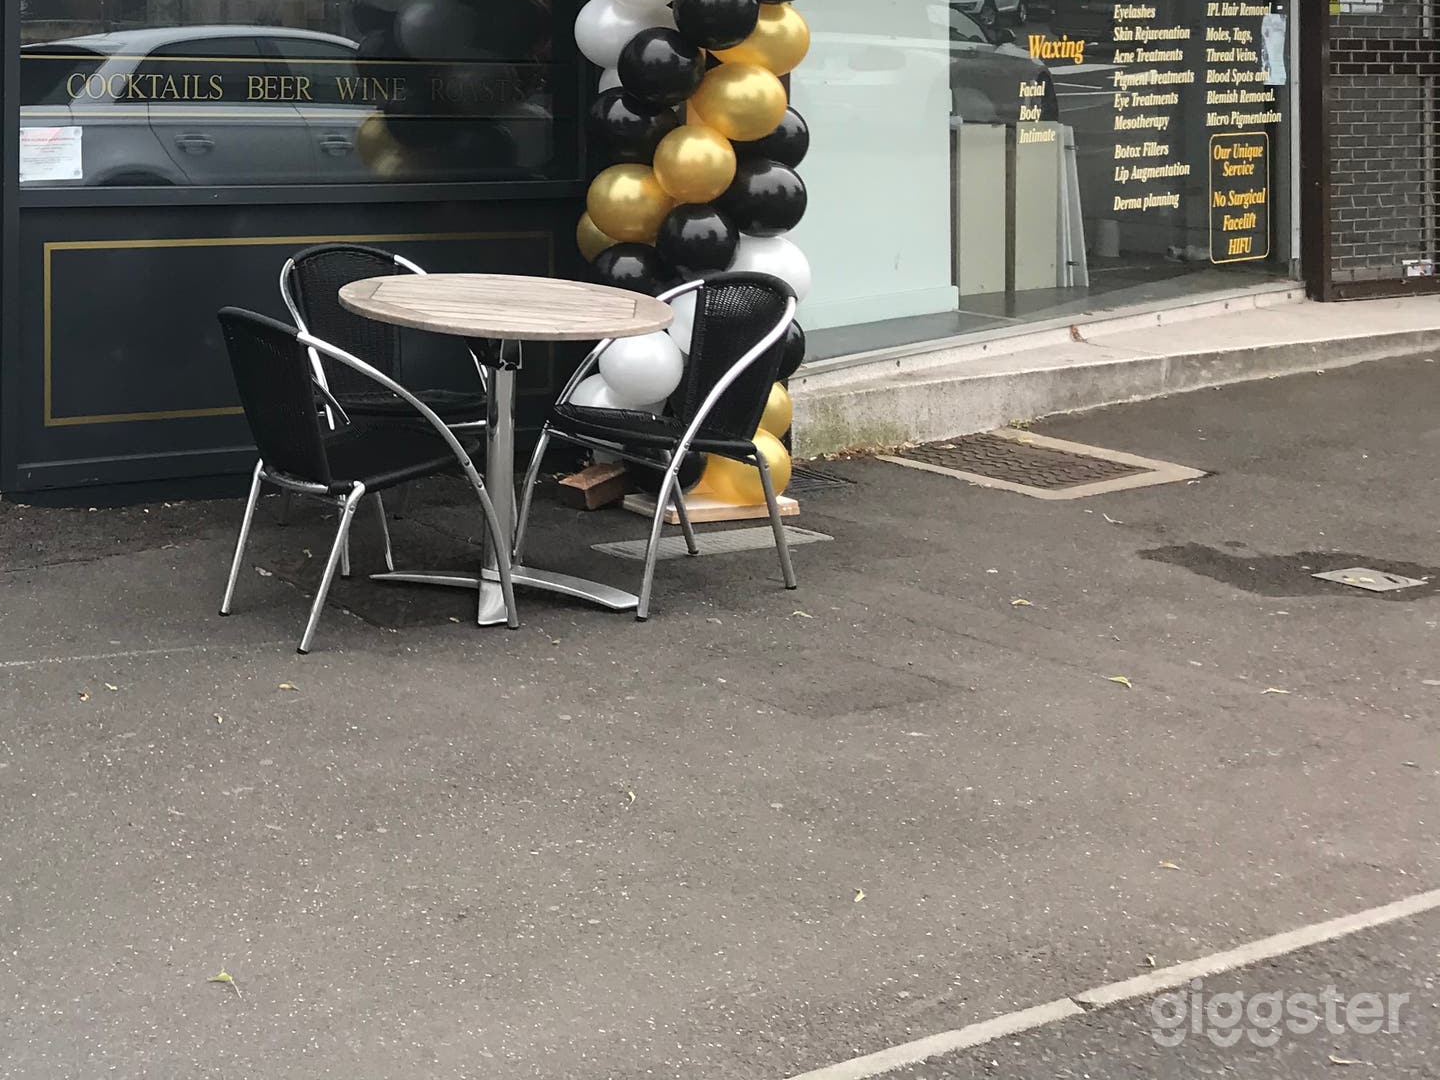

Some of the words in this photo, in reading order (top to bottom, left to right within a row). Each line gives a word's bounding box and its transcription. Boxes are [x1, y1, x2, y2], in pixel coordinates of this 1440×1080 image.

[1114, 4, 1156, 22] Eyelashes
[1207, 3, 1220, 17] IPL
[1221, 3, 1239, 16] Hair
[1240, 2, 1272, 17] Removal
[1113, 26, 1133, 41] Skin
[1135, 25, 1191, 43] Rejuvenation
[1206, 27, 1231, 43] Moles,
[1233, 28, 1253, 44] Tags,
[1028, 34, 1085, 64] Waxing
[1113, 49, 1134, 64] Acne
[1136, 49, 1183, 62] Treatments
[1206, 49, 1235, 62] Thread
[1236, 49, 1258, 63] Veins,
[67, 73, 224, 101] COCKTAILS
[246, 75, 313, 101] BEER
[335, 76, 407, 101] WINE
[1113, 71, 1148, 91] Pigment
[1149, 70, 1195, 84] Treatments
[1206, 70, 1230, 84] Blood
[1231, 70, 1254, 86] Spots
[1255, 71, 1270, 83] and
[1019, 81, 1045, 97] Facial
[1206, 90, 1238, 105] Blemish
[1240, 89, 1275, 104] Removal.
[1114, 94, 1129, 111] Eye
[1132, 92, 1179, 106] Treatments
[1020, 104, 1041, 123] Body
[1114, 114, 1169, 131] Mesotherapy
[1206, 112, 1230, 127] Micro
[1231, 109, 1281, 128] Pigmentation
[1020, 127, 1056, 144] Intimate
[1114, 144, 1141, 159] Botox
[1143, 142, 1169, 157] Fillers
[1213, 145, 1231, 161] Our
[1233, 143, 1264, 161] Unique
[1114, 166, 1130, 184] Lip
[1131, 161, 1191, 182] Augmentation
[1223, 160, 1255, 177] Service
[1113, 196, 1142, 211] Derma
[1143, 192, 1180, 211] planning
[1213, 191, 1227, 208] No
[1228, 187, 1266, 209] Surgical
[1223, 212, 1256, 232] Facelift
[1228, 237, 1252, 255] HIFU
